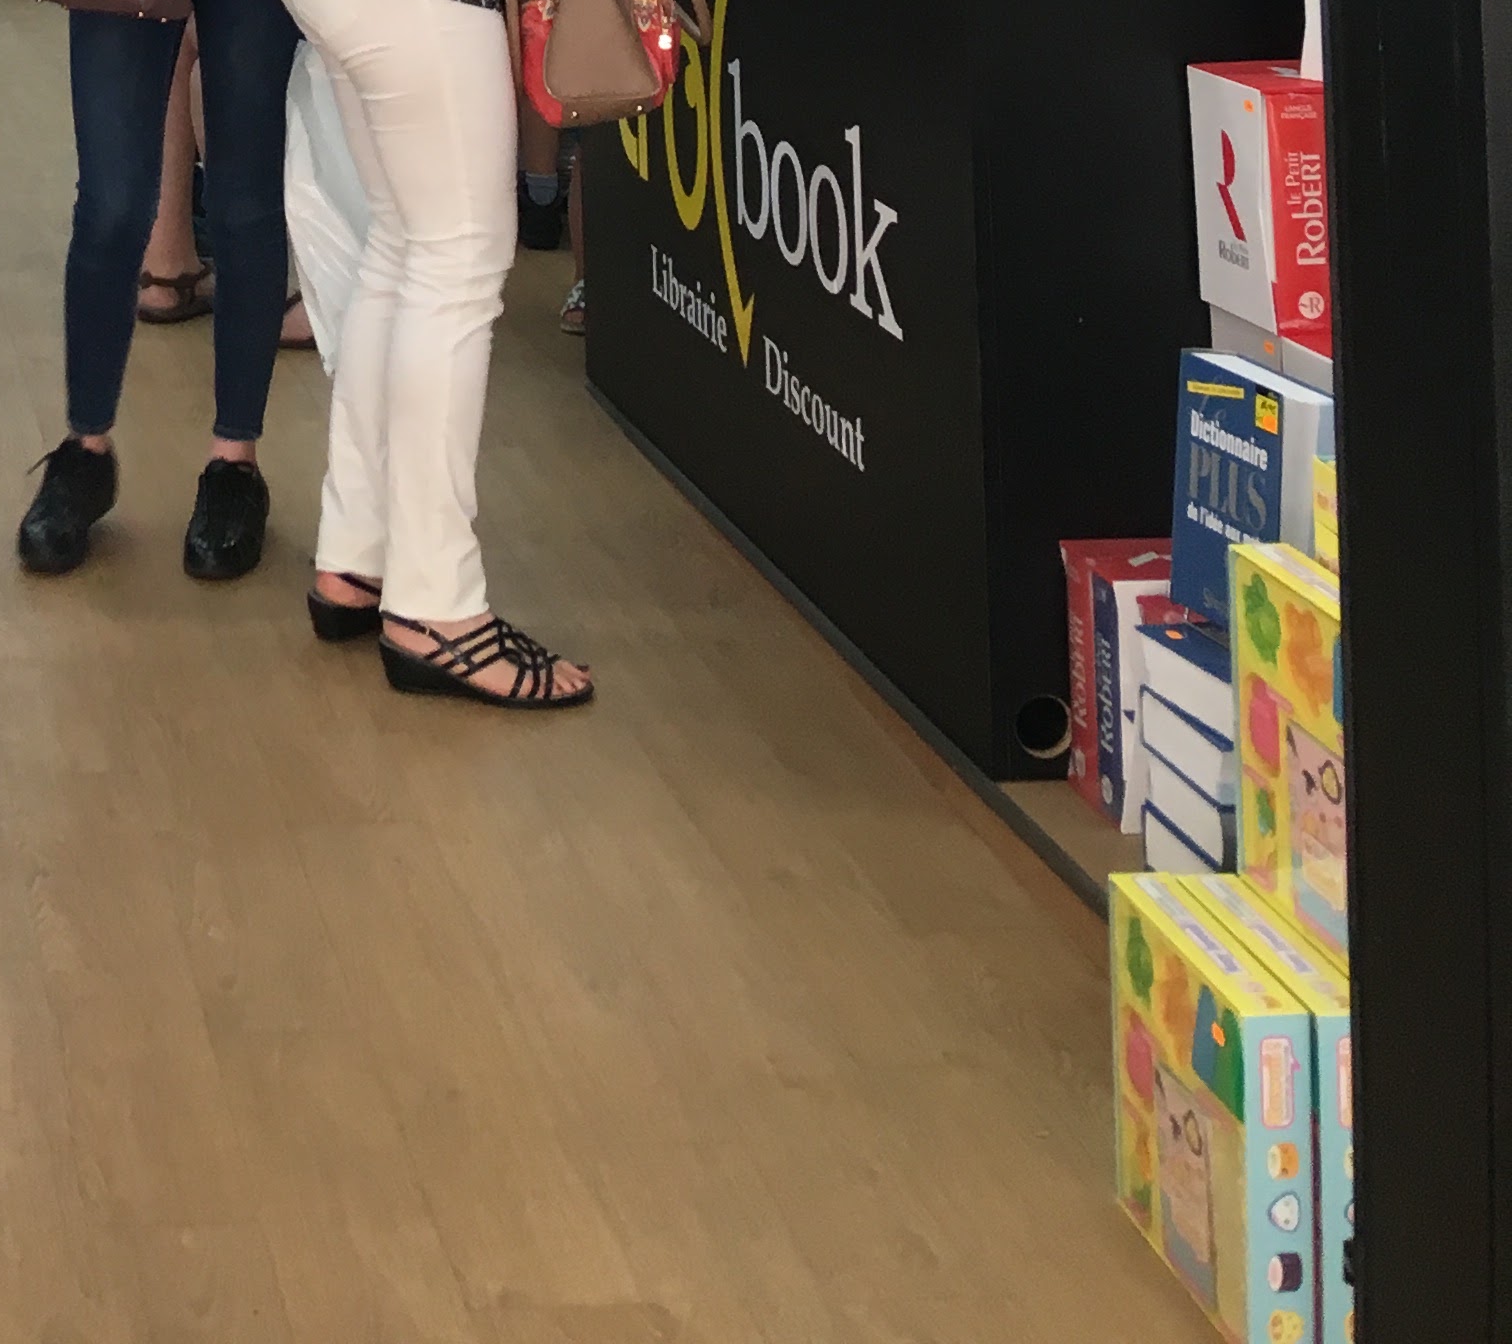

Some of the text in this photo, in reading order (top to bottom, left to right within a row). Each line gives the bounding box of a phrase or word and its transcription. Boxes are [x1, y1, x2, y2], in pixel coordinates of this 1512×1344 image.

[728, 58, 904, 342] book
[650, 244, 866, 472] Librairie Discount
[1190, 442, 1268, 531] PLUS
[1191, 409, 1268, 472] Dictionnaire
